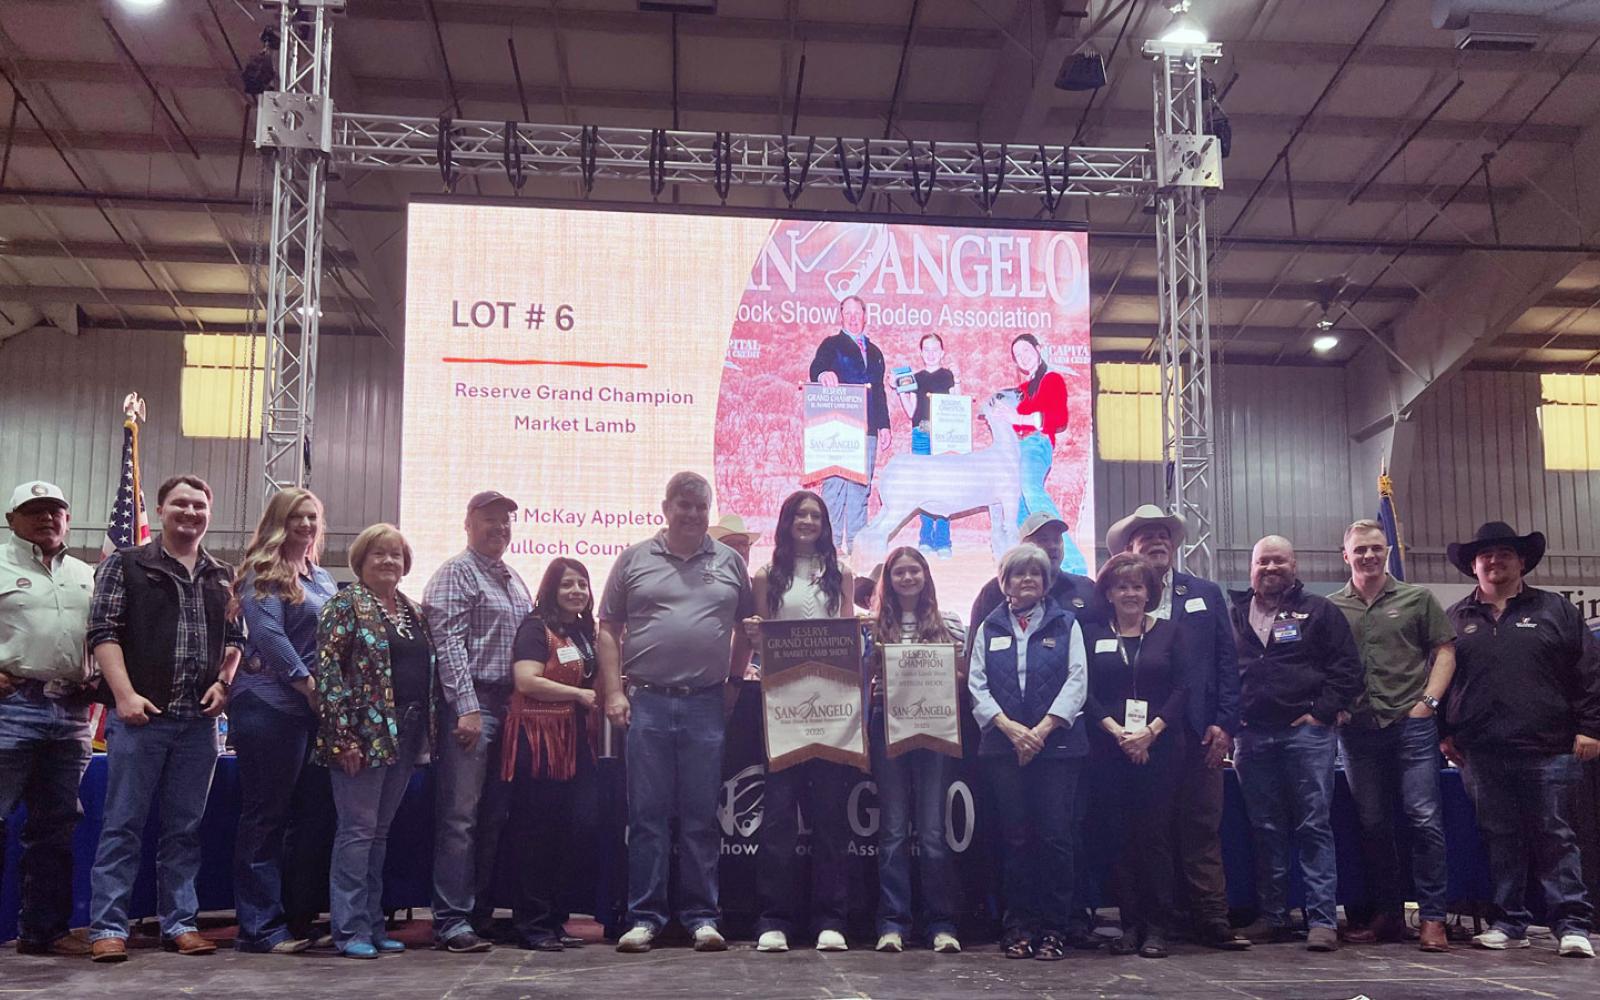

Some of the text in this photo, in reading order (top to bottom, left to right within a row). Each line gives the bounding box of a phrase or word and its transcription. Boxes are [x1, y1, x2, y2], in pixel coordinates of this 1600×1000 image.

[745, 229, 1082, 305] N ANGELO
[451, 300, 576, 332] LOT # 6
[736, 300, 1051, 329] ock Show Rodeo Association
[455, 382, 694, 406] Reserve Grand Champion
[513, 415, 637, 434] Market Lamb
[524, 508, 587, 528] McKay
[591, 509, 665, 528] Appleto
[510, 539, 569, 555] ulloch
[767, 635, 855, 649] GRAND CHAMPION
[898, 658, 944, 669] CHAMPION
[902, 649, 938, 659] RESERVE
[774, 705, 798, 721] SAN
[810, 703, 853, 718] ANGELO
[892, 705, 952, 717] SAN ANGELO
[719, 838, 760, 857] how
